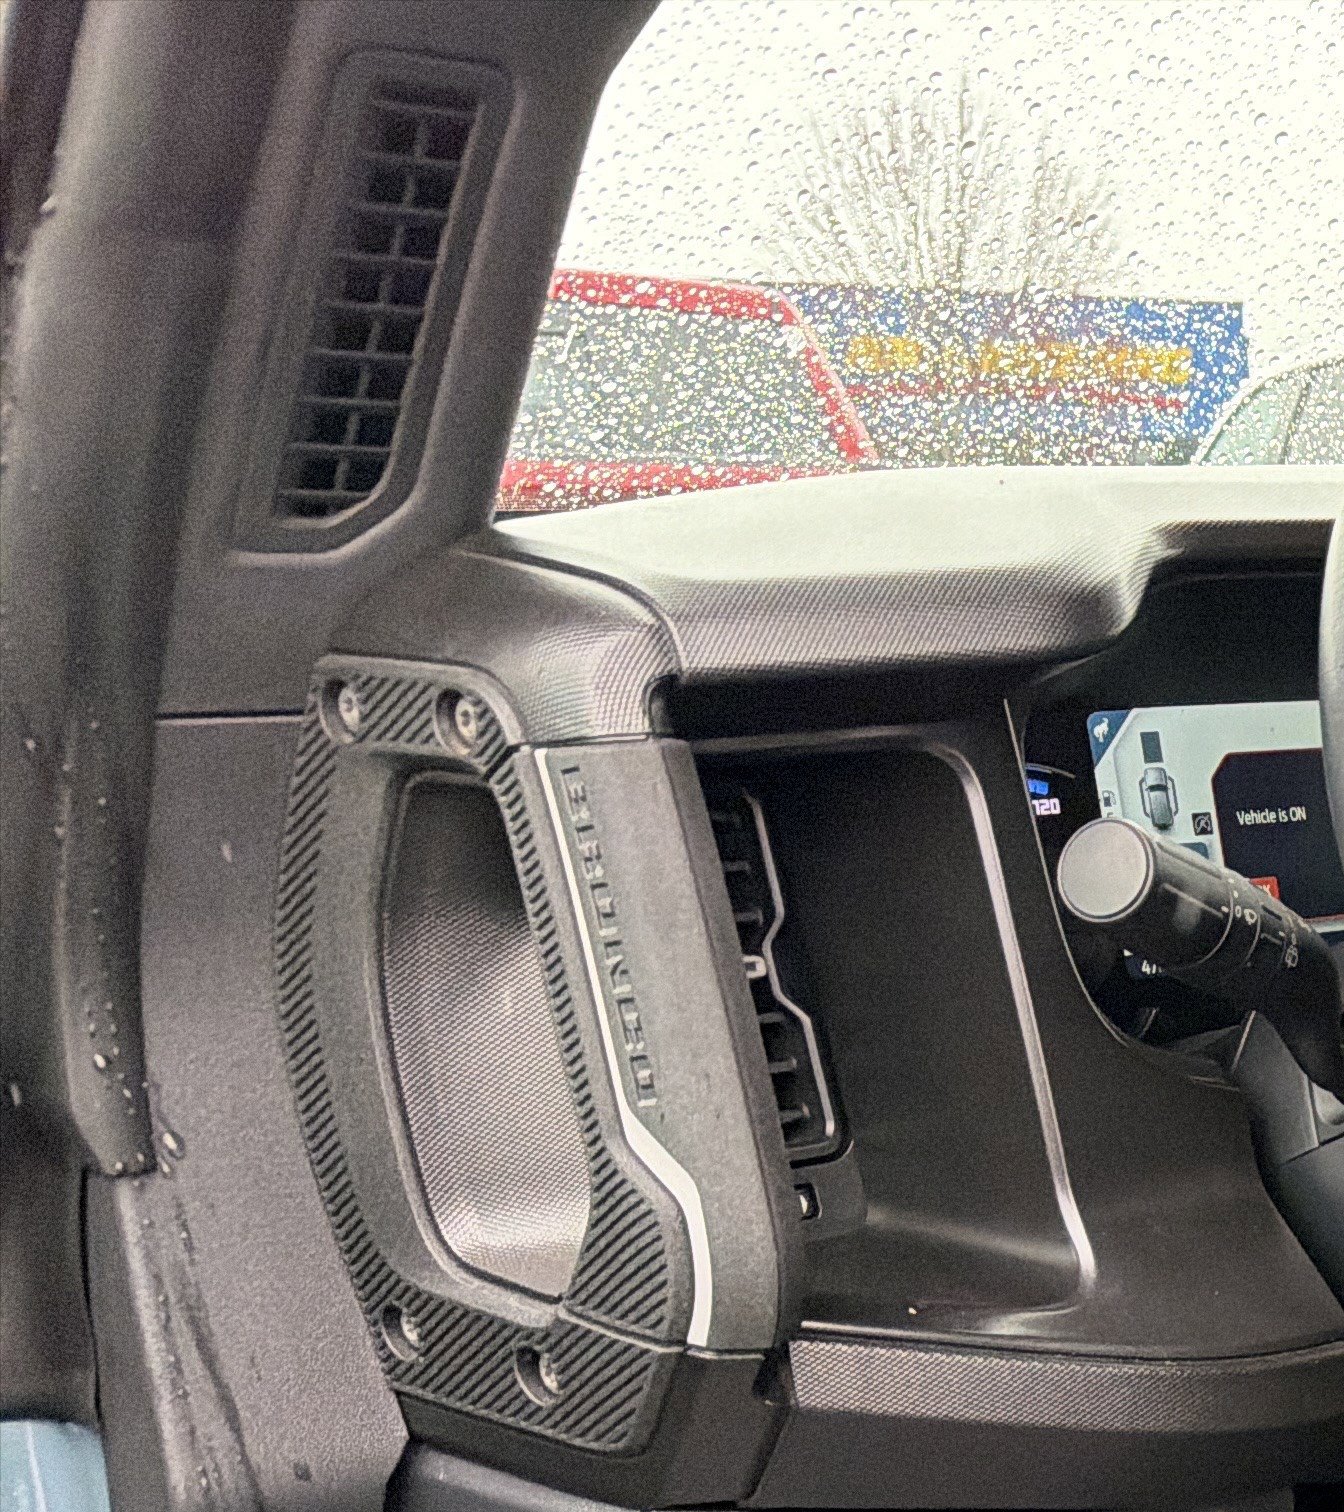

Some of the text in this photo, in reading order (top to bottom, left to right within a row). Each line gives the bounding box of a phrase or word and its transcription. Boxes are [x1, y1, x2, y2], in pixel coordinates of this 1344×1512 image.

[1031, 797, 1062, 816] 120
[1236, 806, 1307, 826] Vehicle is ON
[560, 765, 657, 1107] BRONCO
